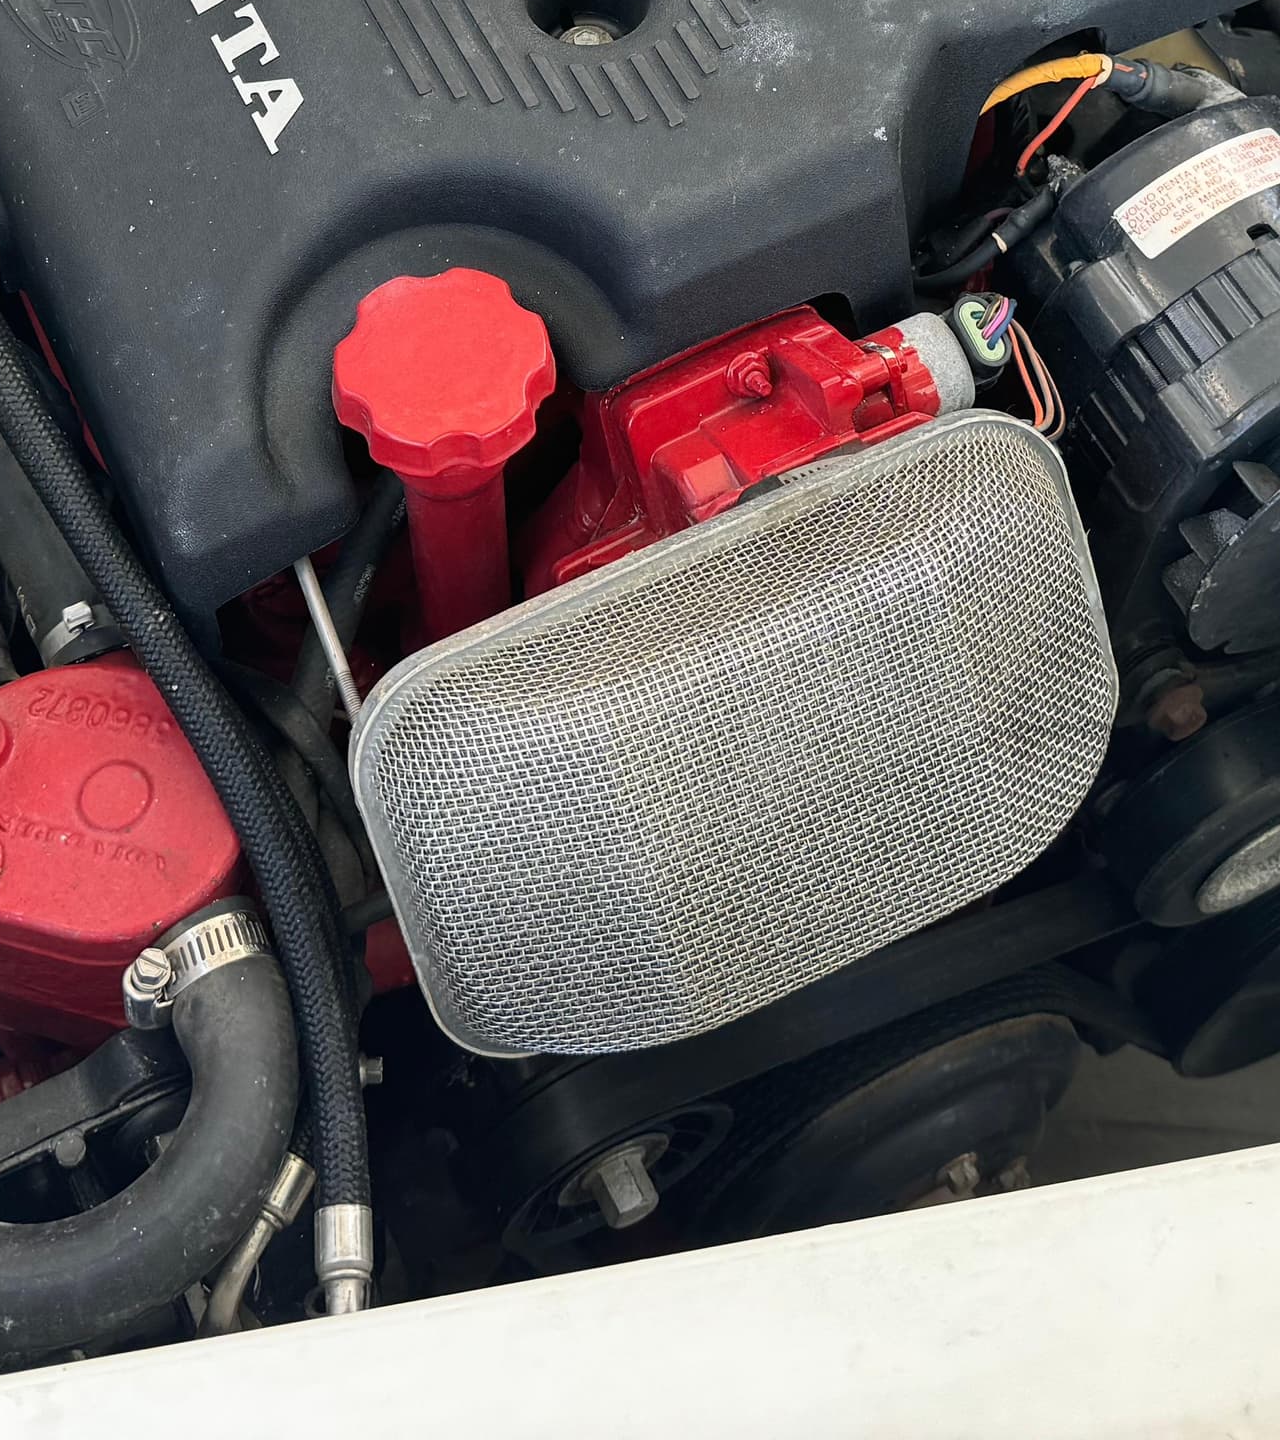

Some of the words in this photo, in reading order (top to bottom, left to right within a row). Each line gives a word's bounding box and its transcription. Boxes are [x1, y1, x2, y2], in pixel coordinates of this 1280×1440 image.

[1121, 187, 1156, 220] VOLVO
[1157, 168, 1192, 195] PENTA
[1192, 153, 1220, 173] PART
[1127, 192, 1172, 229] OUTPUT
[1177, 175, 1199, 192] 12V
[1131, 201, 1176, 236] VENDOR
[1176, 184, 1204, 206] PART
[1173, 202, 1194, 221] SAE
[1198, 178, 1238, 205] MARINE
